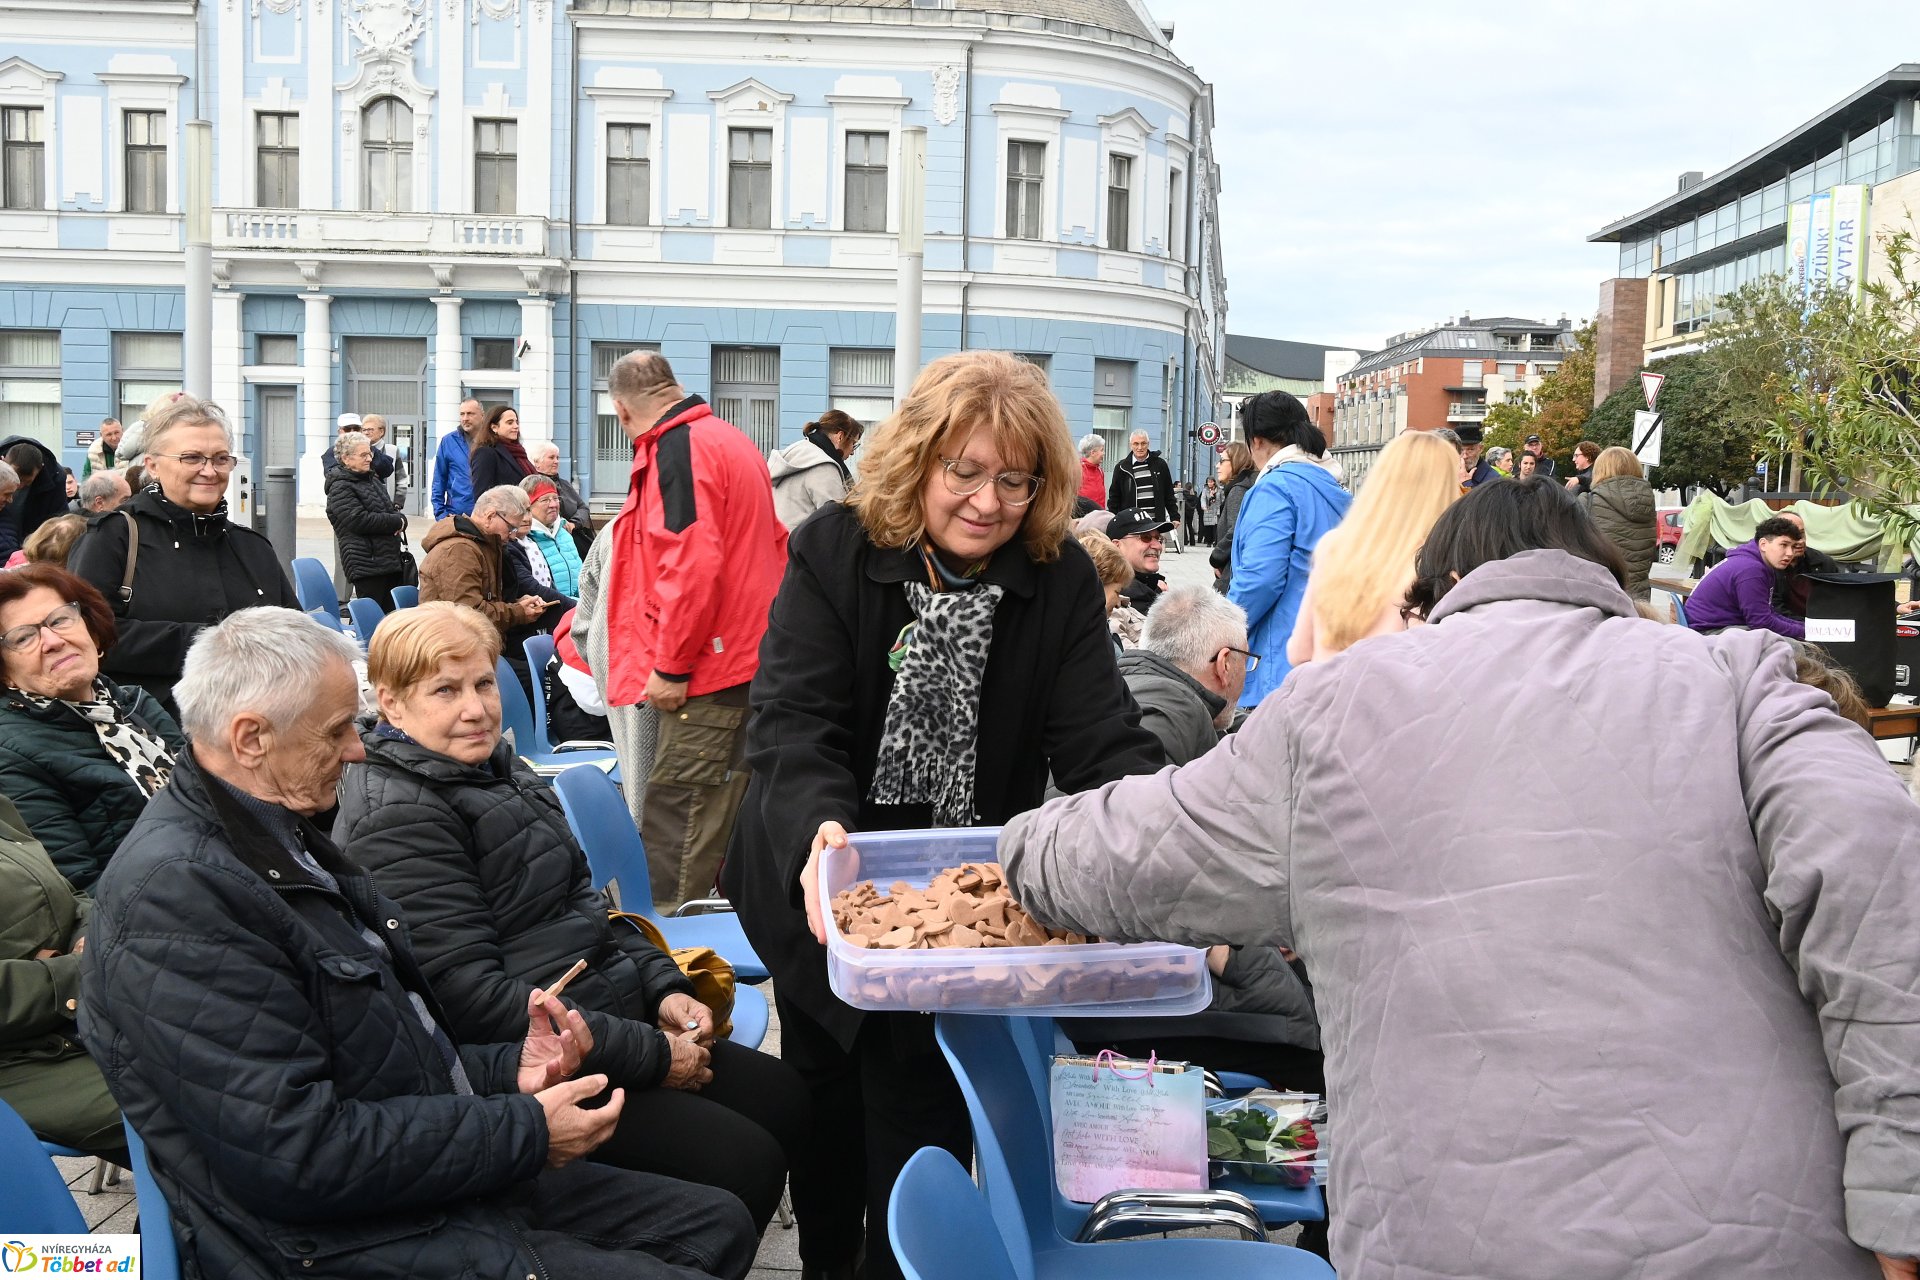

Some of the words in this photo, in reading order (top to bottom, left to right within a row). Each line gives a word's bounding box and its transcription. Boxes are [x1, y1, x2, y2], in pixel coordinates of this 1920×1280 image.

[1122, 1086, 1138, 1094] Love
[1094, 1132, 1117, 1142] WITH
[1119, 1134, 1139, 1144] LOVE
